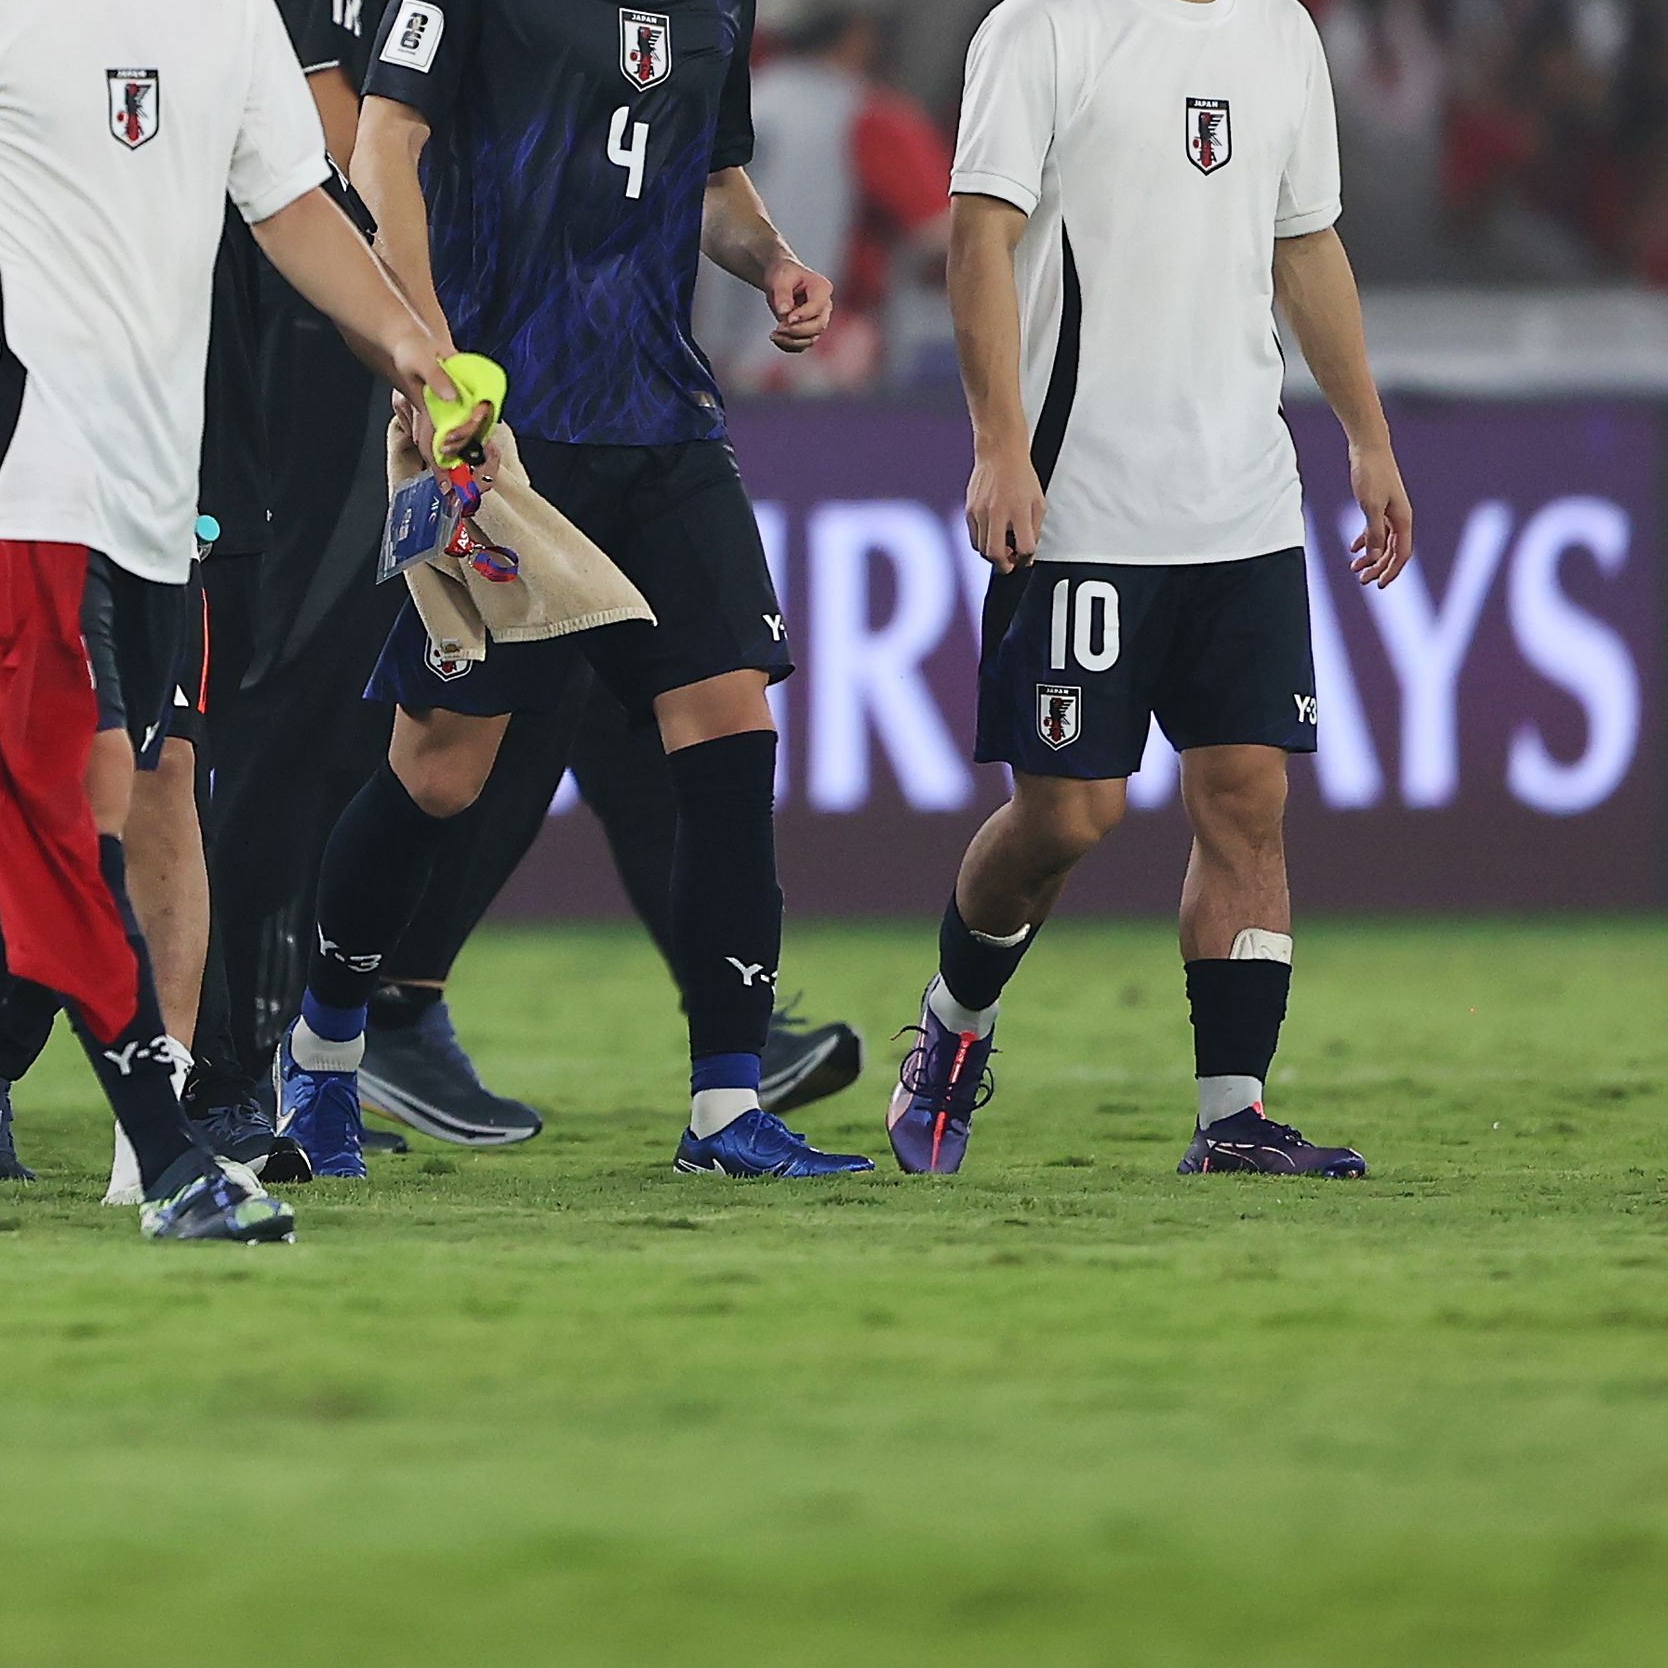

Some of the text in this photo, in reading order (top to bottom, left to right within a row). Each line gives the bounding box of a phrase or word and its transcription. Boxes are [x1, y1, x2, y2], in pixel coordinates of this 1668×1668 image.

[631, 13, 657, 24] JAPAN
[607, 106, 649, 198] 4
[762, 614, 788, 641] Y-
[1050, 579, 1119, 672] 10
[1293, 694, 1317, 725] Y-3
[316, 921, 382, 973] Y-3
[103, 1035, 172, 1075] Y-3
